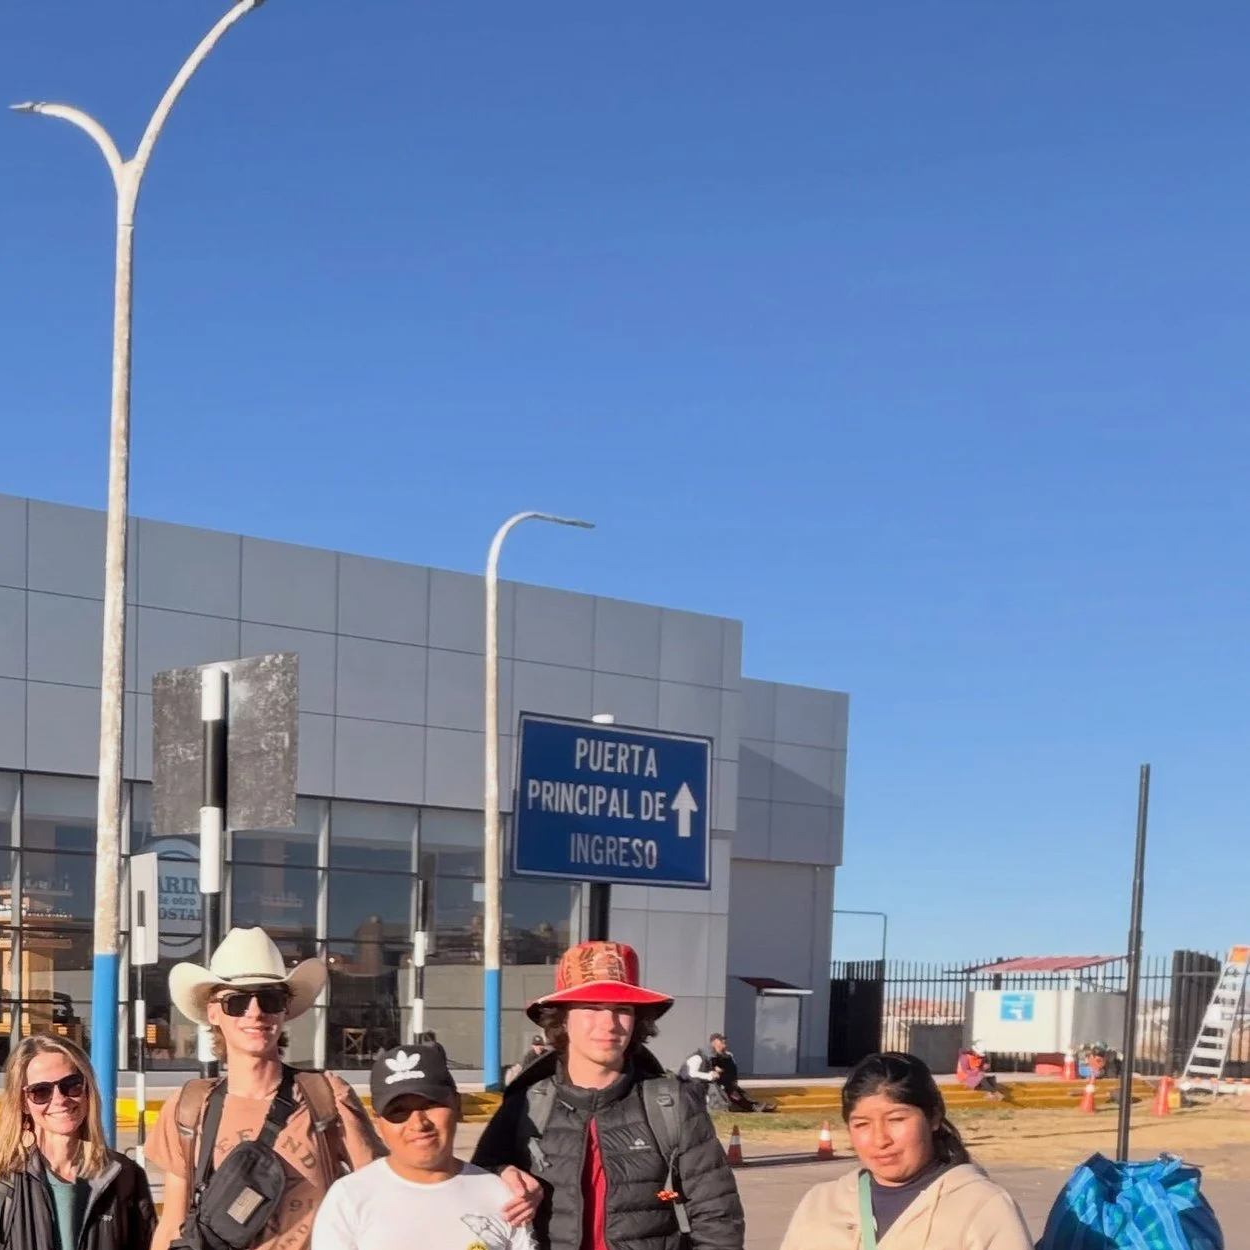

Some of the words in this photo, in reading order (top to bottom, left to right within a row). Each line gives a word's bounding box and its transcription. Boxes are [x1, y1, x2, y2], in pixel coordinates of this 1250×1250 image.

[574, 737, 658, 778] PUERTA
[527, 779, 635, 820] PRINCIPAL
[640, 789, 667, 822] DE
[569, 832, 658, 870] INGRESO
